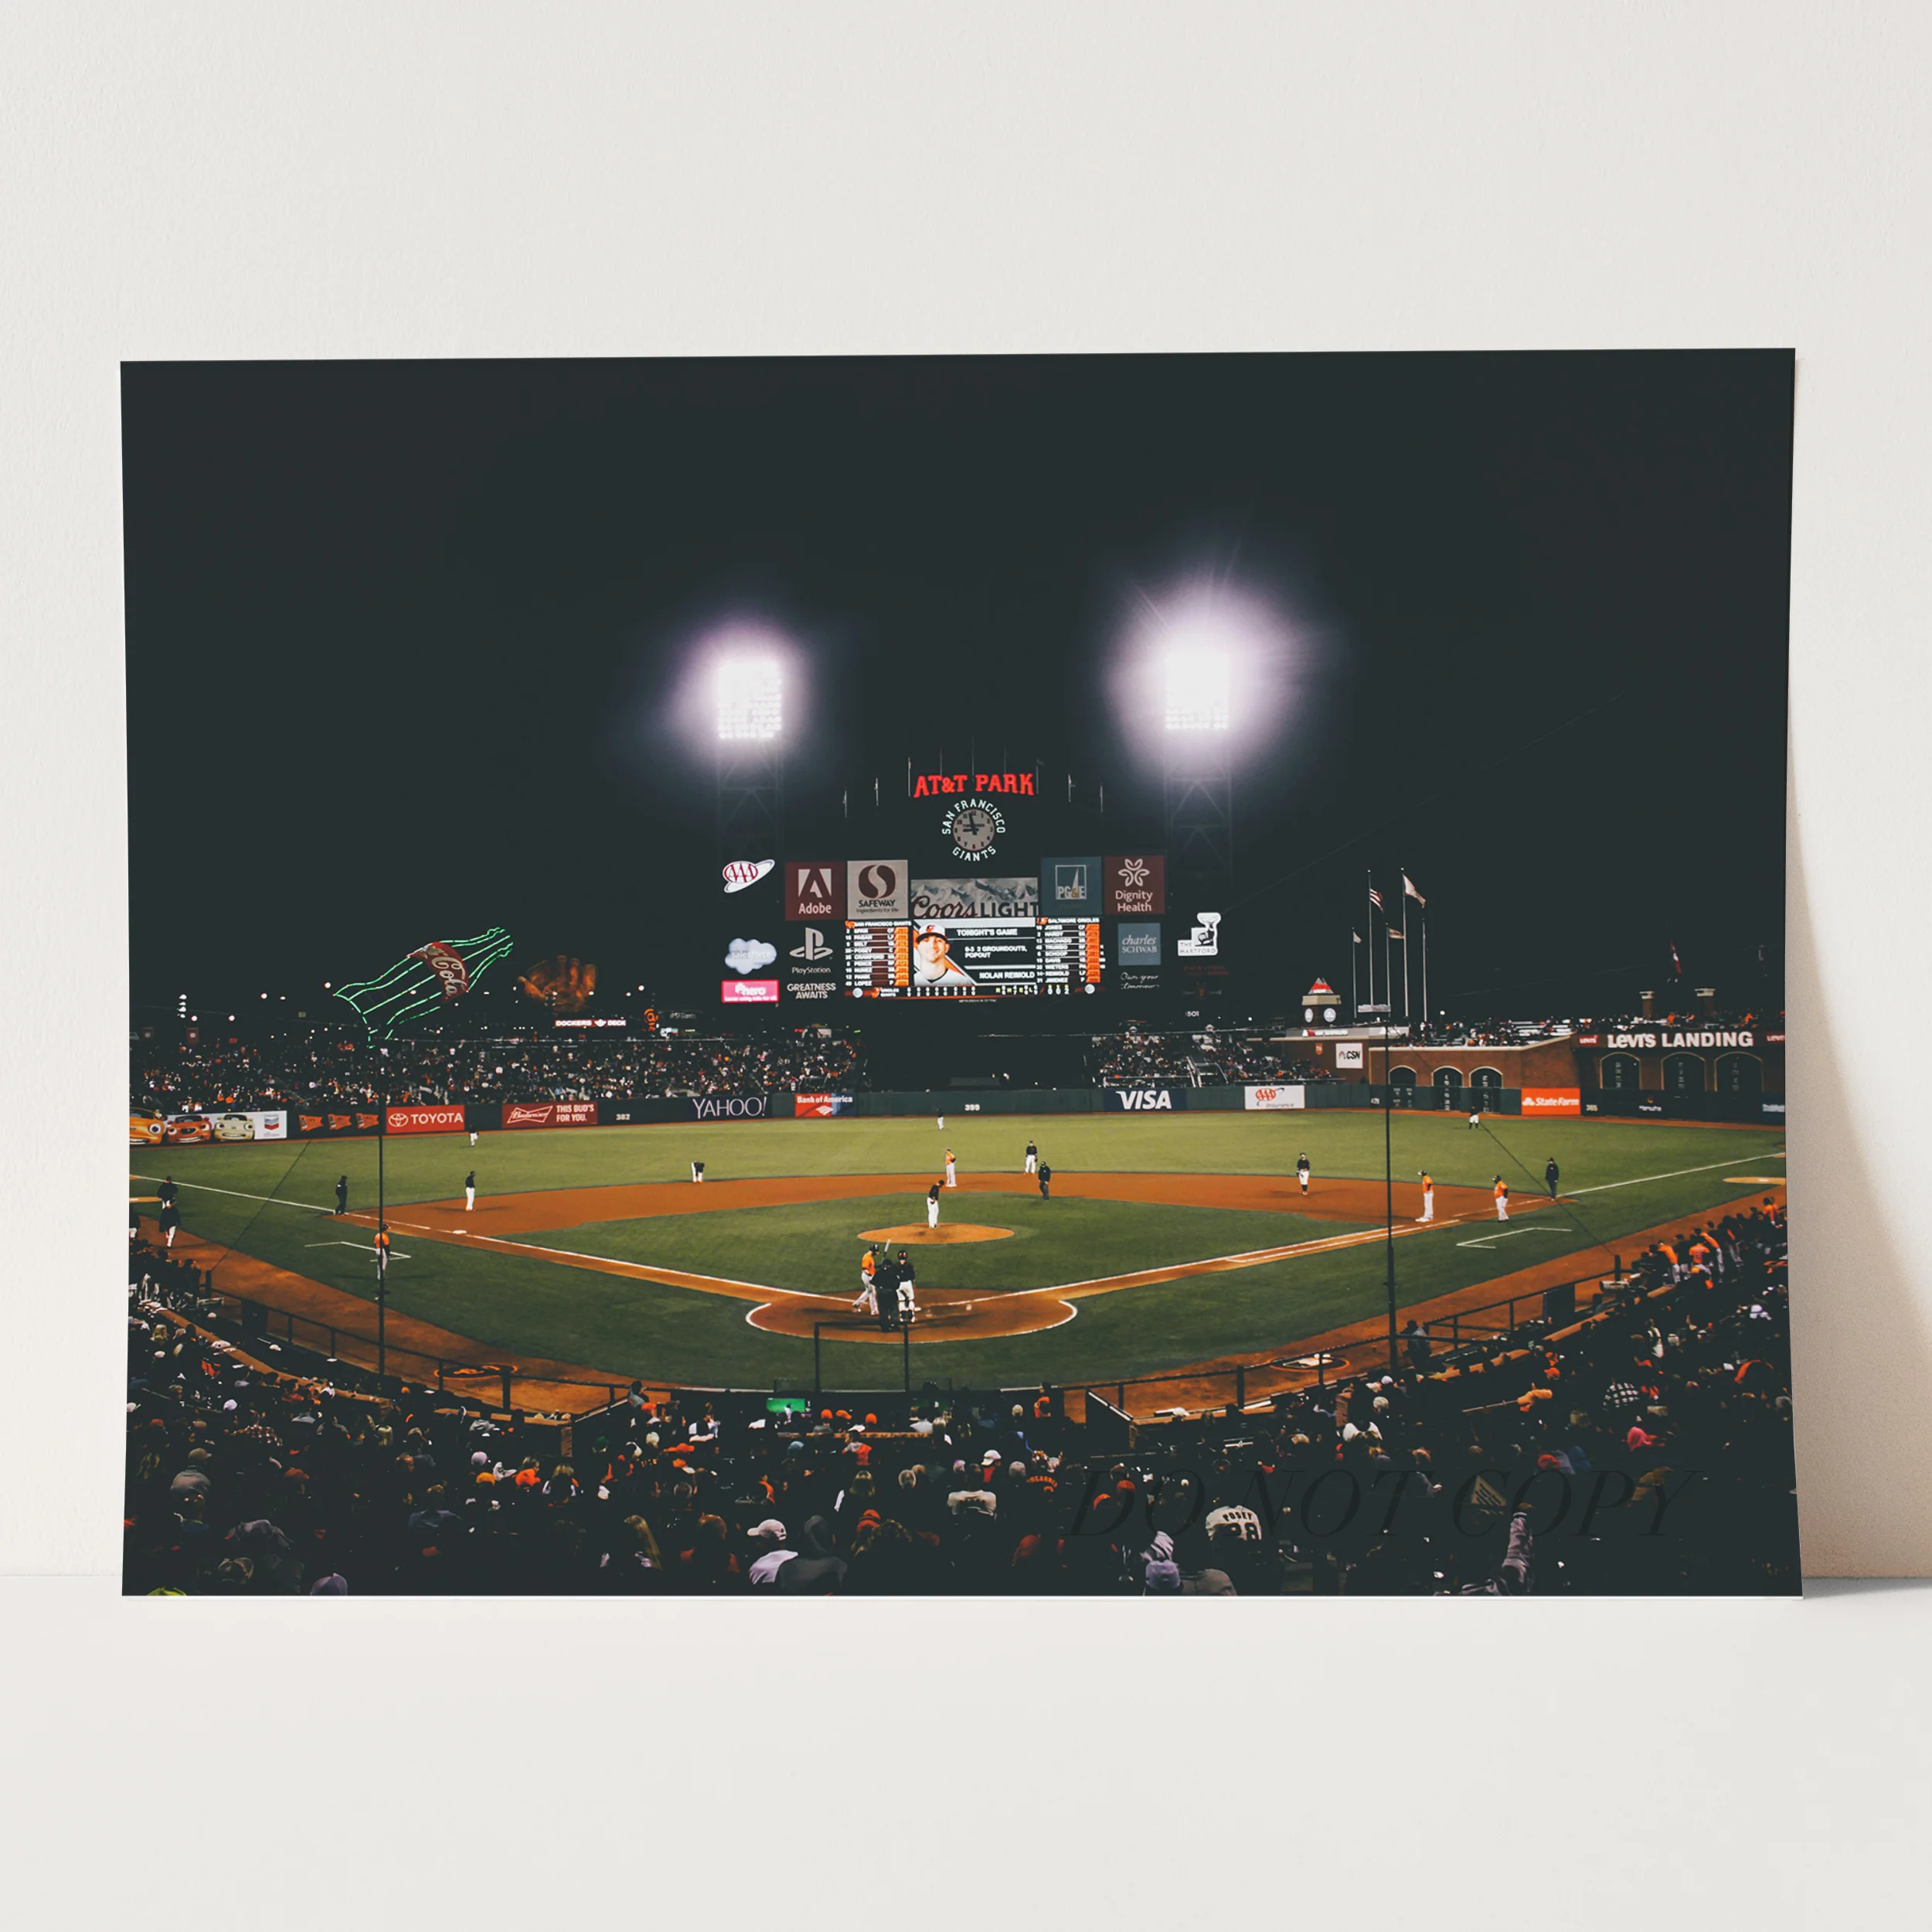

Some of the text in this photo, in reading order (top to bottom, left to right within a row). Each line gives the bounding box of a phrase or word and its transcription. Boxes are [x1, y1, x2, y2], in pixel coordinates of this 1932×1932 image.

[913, 773, 1035, 798] AT&T PARK
[942, 798, 1005, 835] SAN FRANCISCO
[952, 845, 996, 862] GIANTS
[724, 862, 758, 883] AAA
[1057, 886, 1086, 900] PG&E
[1115, 890, 1153, 902] Dignity
[799, 903, 832, 914] Adobe
[912, 895, 1038, 918] Coors LIGHT
[1117, 903, 1152, 912] Health
[1122, 934, 1156, 945] charles
[731, 950, 771, 961] salesforce
[787, 983, 836, 992] GREATNESS
[1662, 1032, 1753, 1048] LANDING
[1346, 1051, 1360, 1060] CSN
[1116, 1090, 1172, 1110] VISA
[1256, 1088, 1276, 1101] AAA
[1536, 1097, 1580, 1106] State Farm
[692, 1097, 767, 1119] YAHOO!
[410, 1113, 463, 1124] TOYOTA
[1223, 1512, 1253, 1522] POSEY
